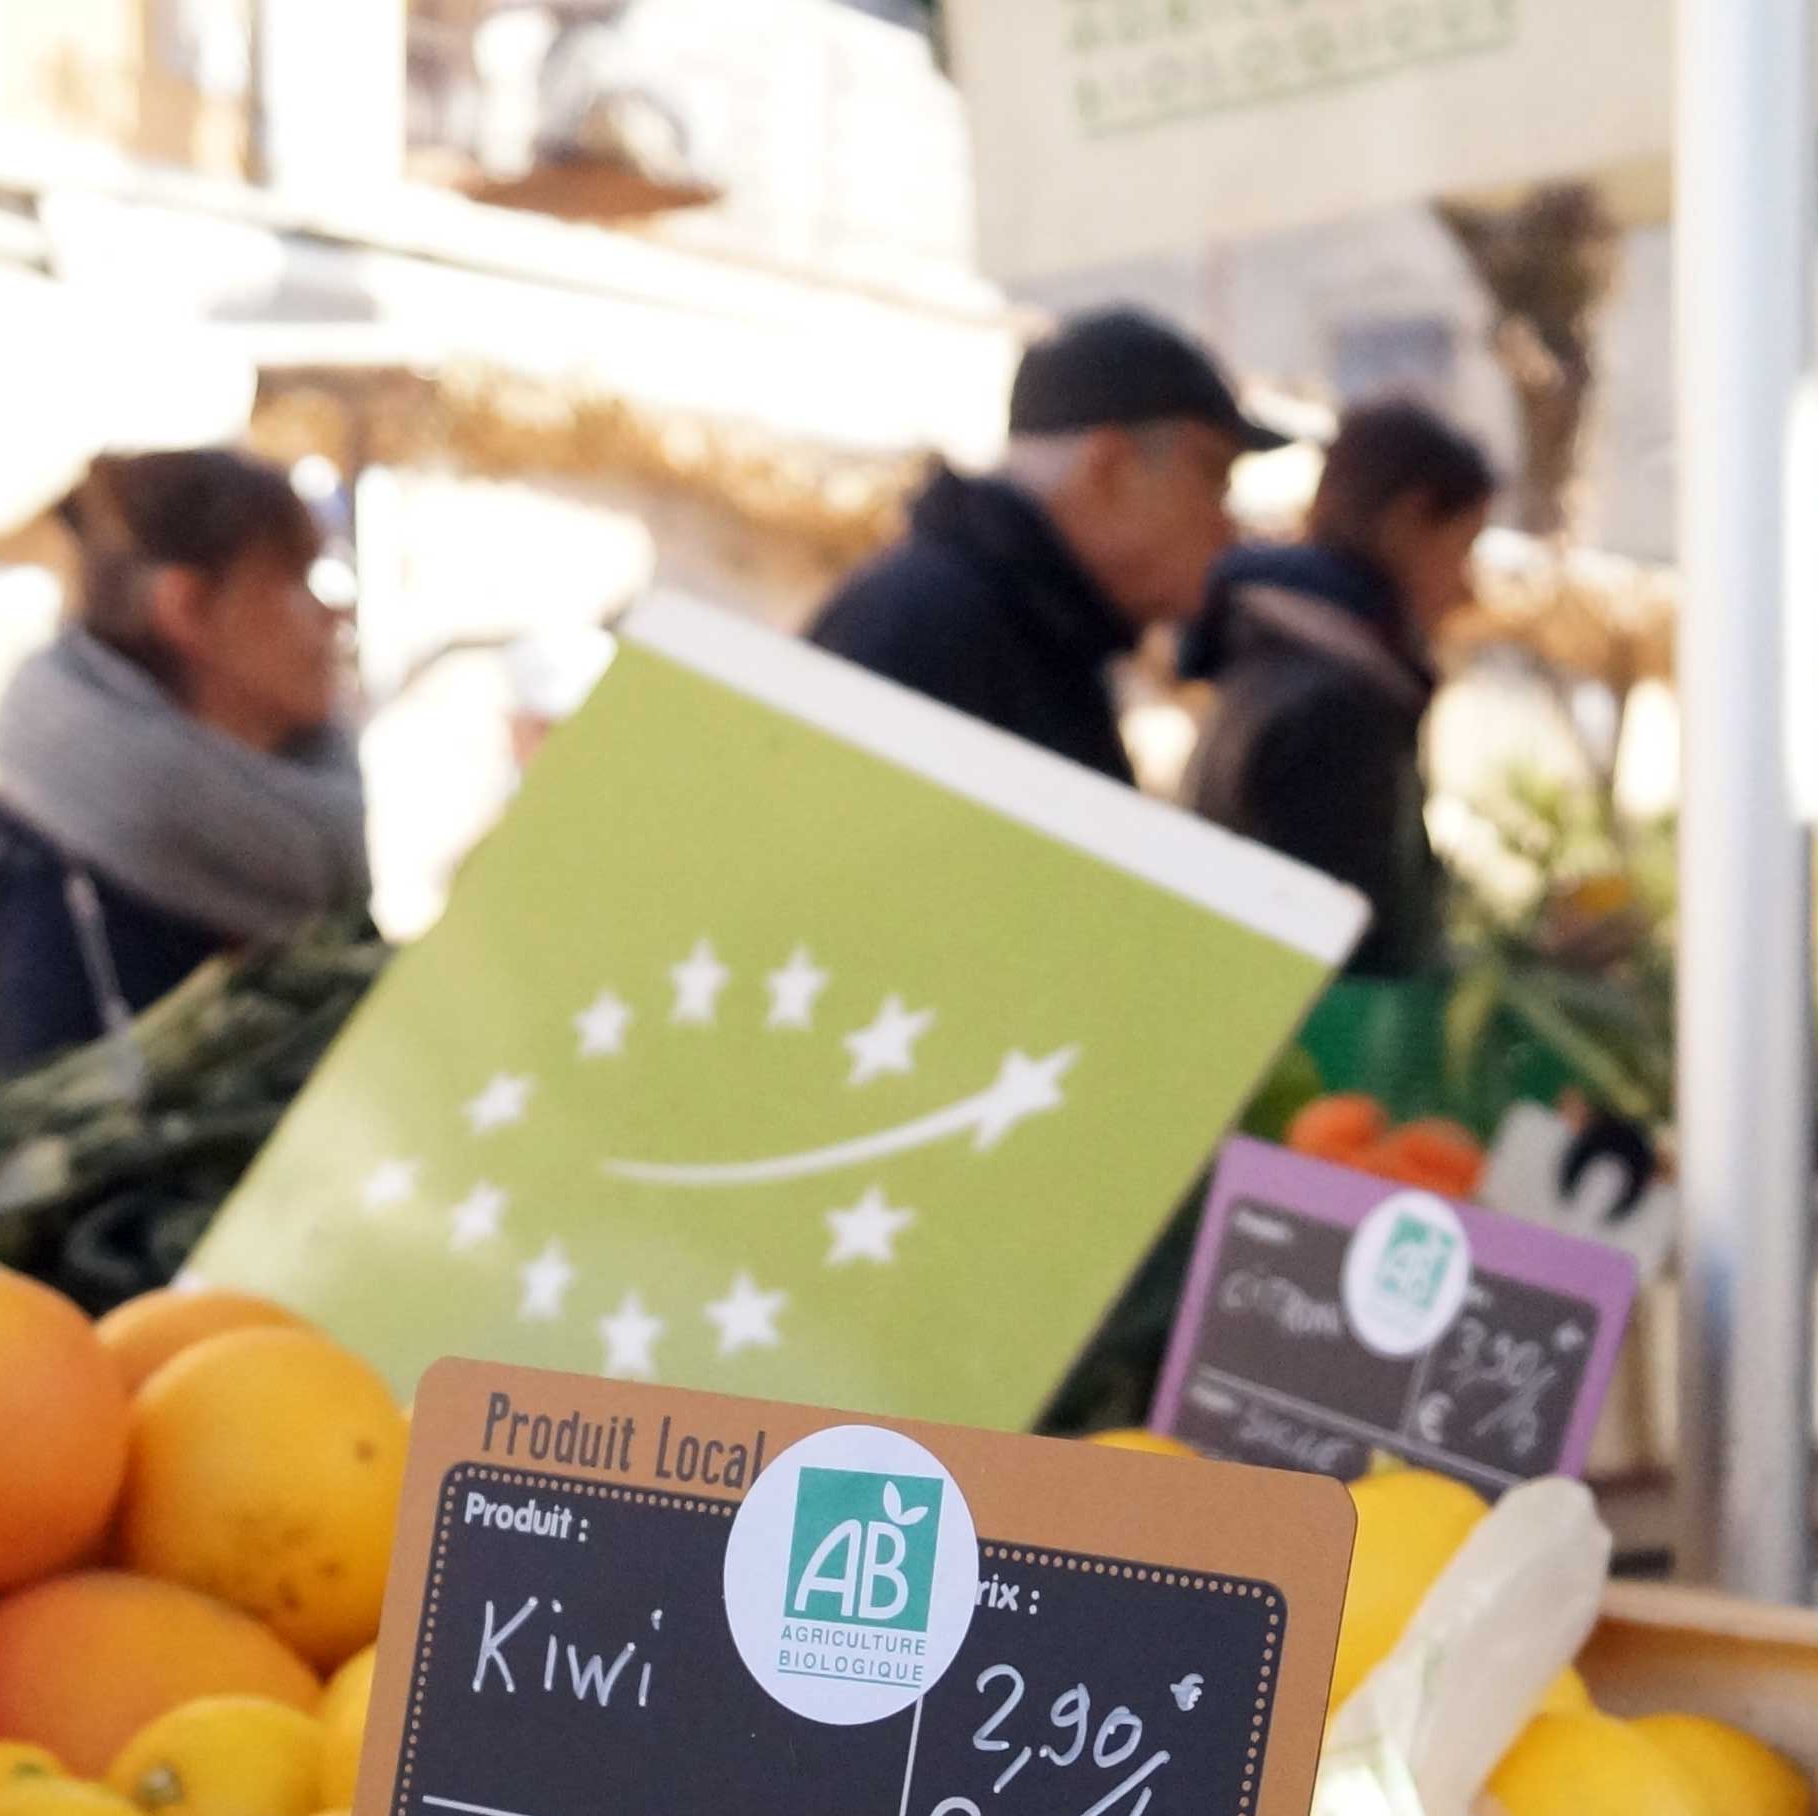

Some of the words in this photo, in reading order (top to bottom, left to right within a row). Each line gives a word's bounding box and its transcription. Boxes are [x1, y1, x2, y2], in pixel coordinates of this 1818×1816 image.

[482, 1392, 636, 1472] Produit
[655, 1415, 767, 1490] Local
[793, 1518, 909, 1620] AB
[472, 1595, 663, 1707] Kiwi
[778, 1650, 924, 1683] BIOLOGIQUE
[780, 1624, 928, 1657] AGRICULTURE
